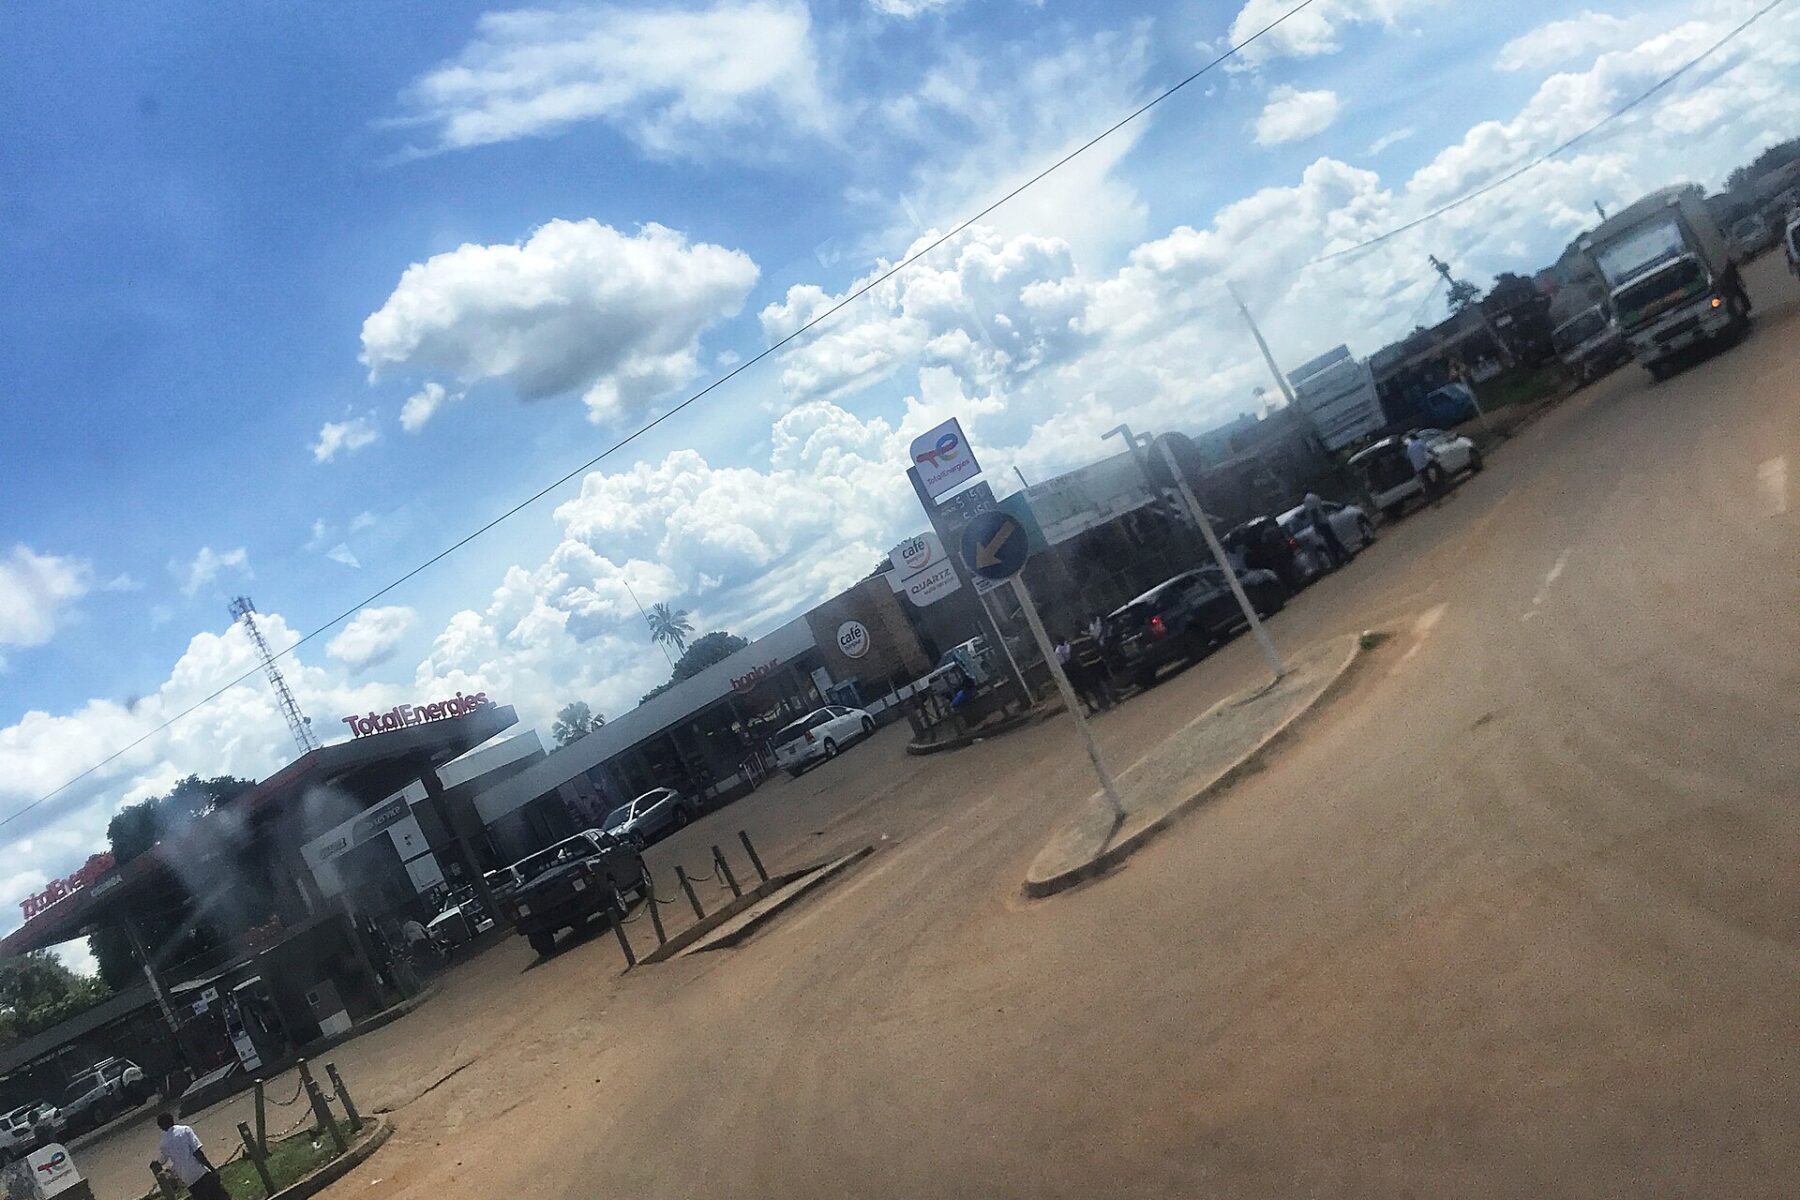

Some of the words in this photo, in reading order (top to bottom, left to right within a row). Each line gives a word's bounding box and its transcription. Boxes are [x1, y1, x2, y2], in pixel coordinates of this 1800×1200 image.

[902, 537, 925, 559] café
[911, 568, 951, 594] QUARTZ
[840, 625, 861, 645] café
[730, 657, 777, 690] bonjour
[342, 691, 488, 738] TotalEnergies
